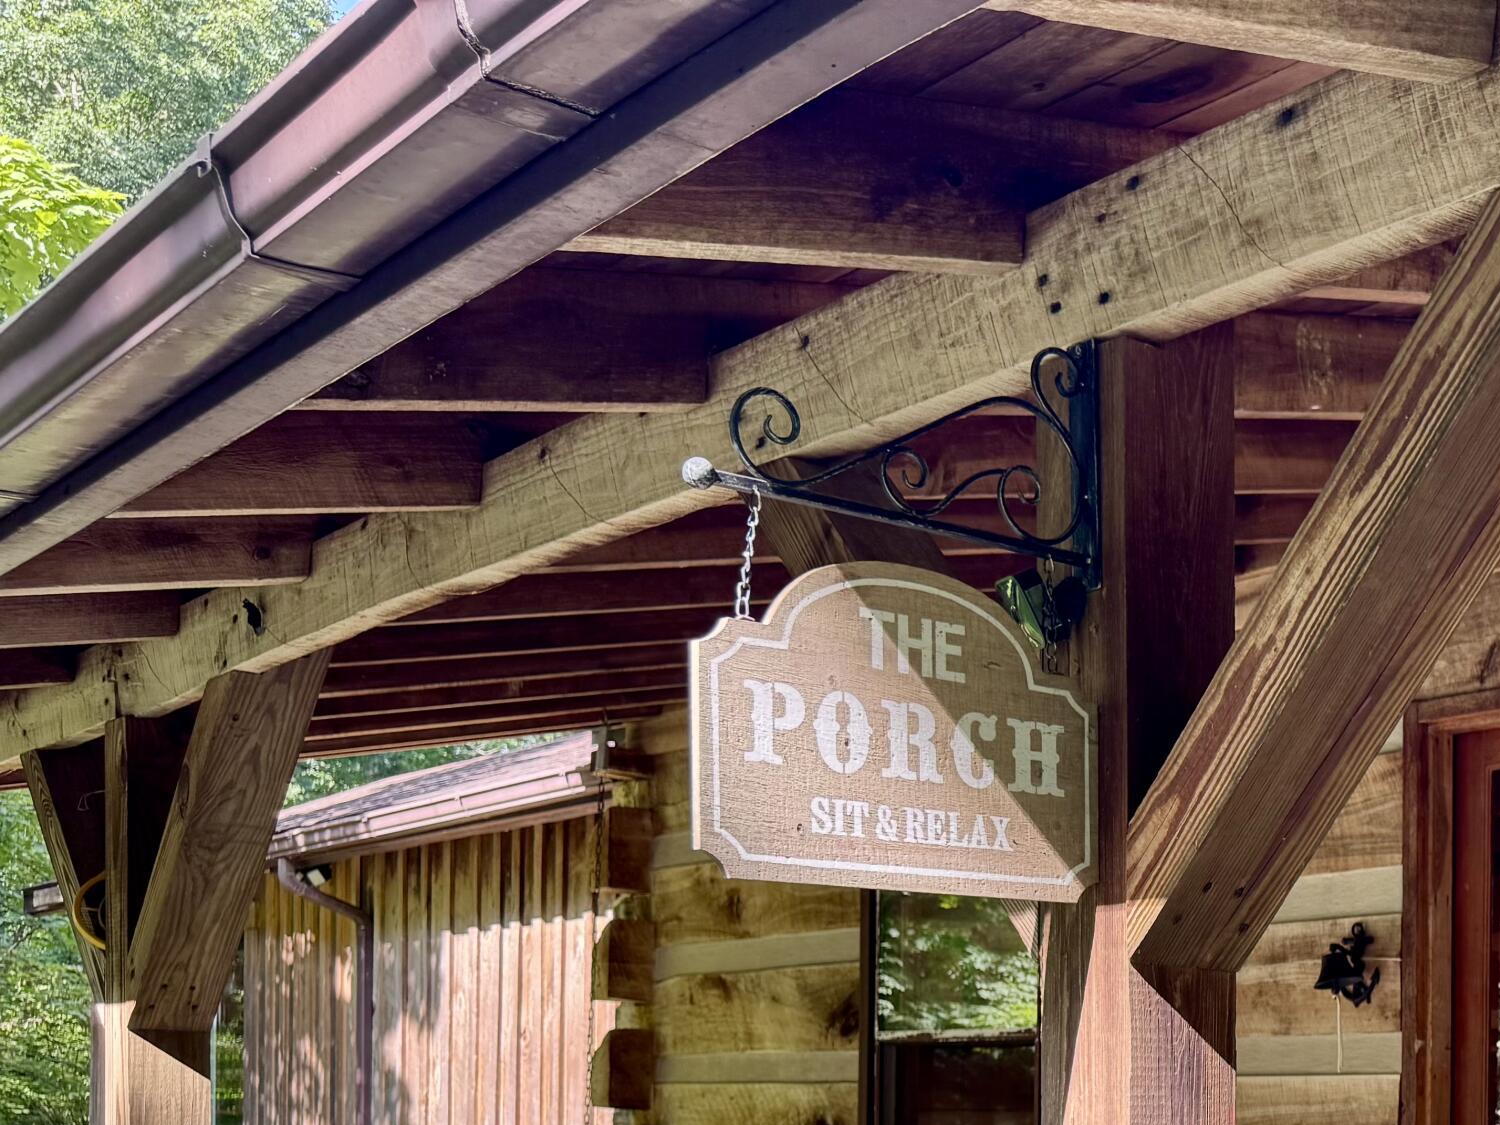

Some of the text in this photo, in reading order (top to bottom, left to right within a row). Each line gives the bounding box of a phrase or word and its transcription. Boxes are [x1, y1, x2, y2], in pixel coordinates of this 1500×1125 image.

[859, 606, 967, 684] THE
[743, 679, 1066, 798] PORCH
[810, 796, 1014, 852] SIT & RELAX
